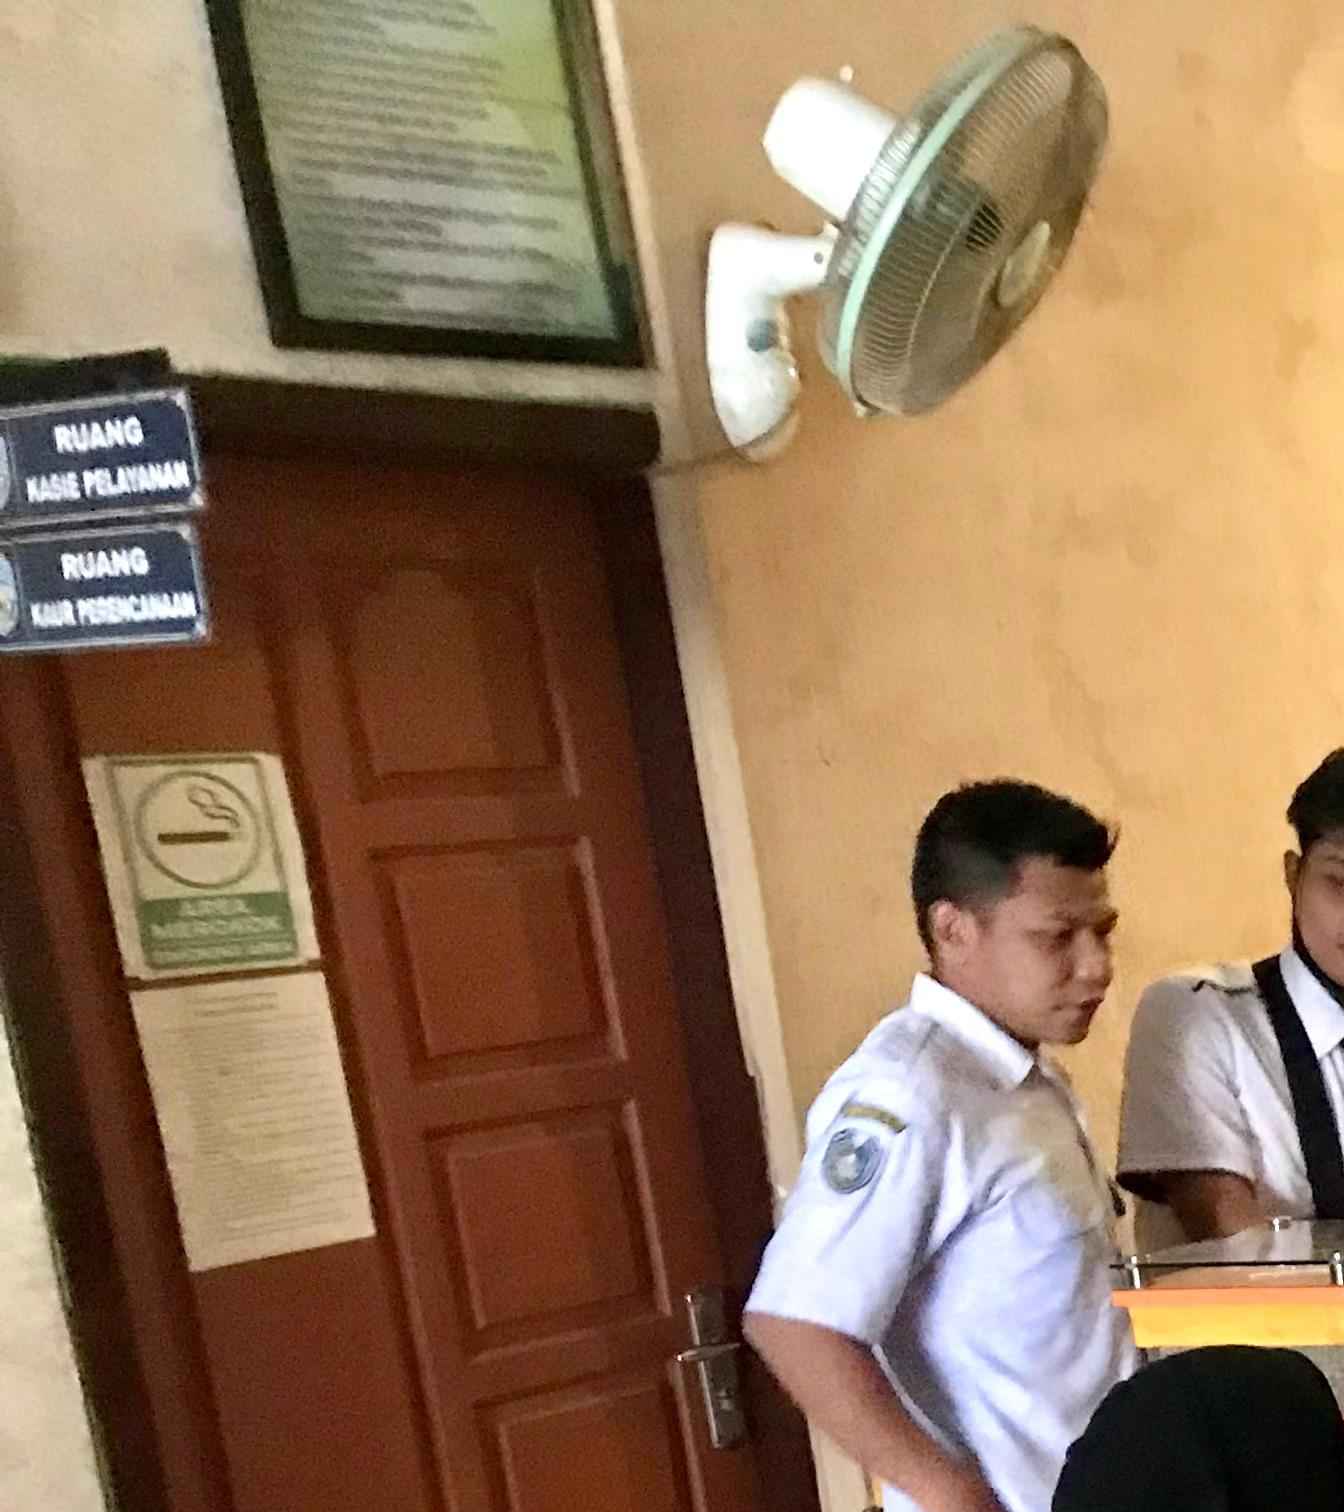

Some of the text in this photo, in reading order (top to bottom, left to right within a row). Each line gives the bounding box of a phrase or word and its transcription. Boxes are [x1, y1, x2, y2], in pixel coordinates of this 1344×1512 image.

[54, 416, 144, 453] RUANG
[26, 460, 190, 502] KASIE PELAYANAN
[61, 547, 149, 580] RUANG
